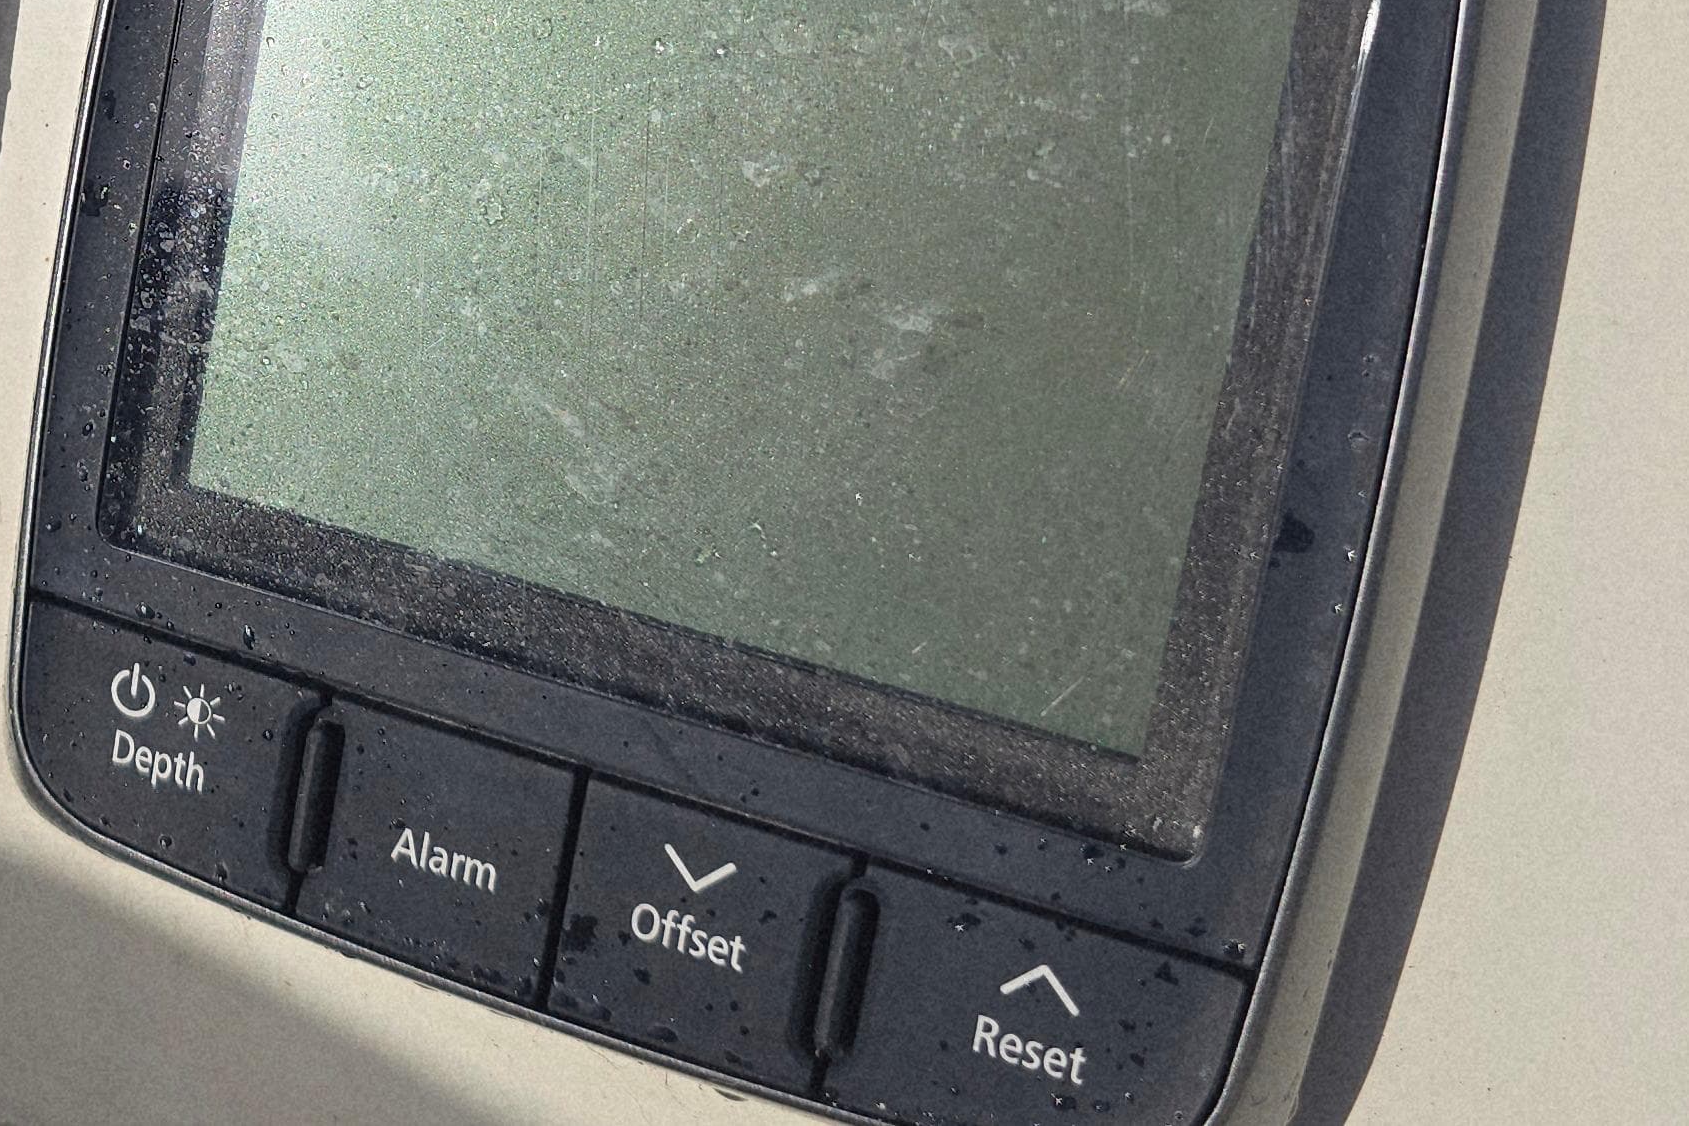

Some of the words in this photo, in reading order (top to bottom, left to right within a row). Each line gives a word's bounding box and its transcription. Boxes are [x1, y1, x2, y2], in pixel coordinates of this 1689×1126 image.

[112, 729, 206, 792] Depth
[390, 827, 498, 893] Alarm
[630, 902, 747, 973] Offset
[972, 1014, 1087, 1085] Reset
